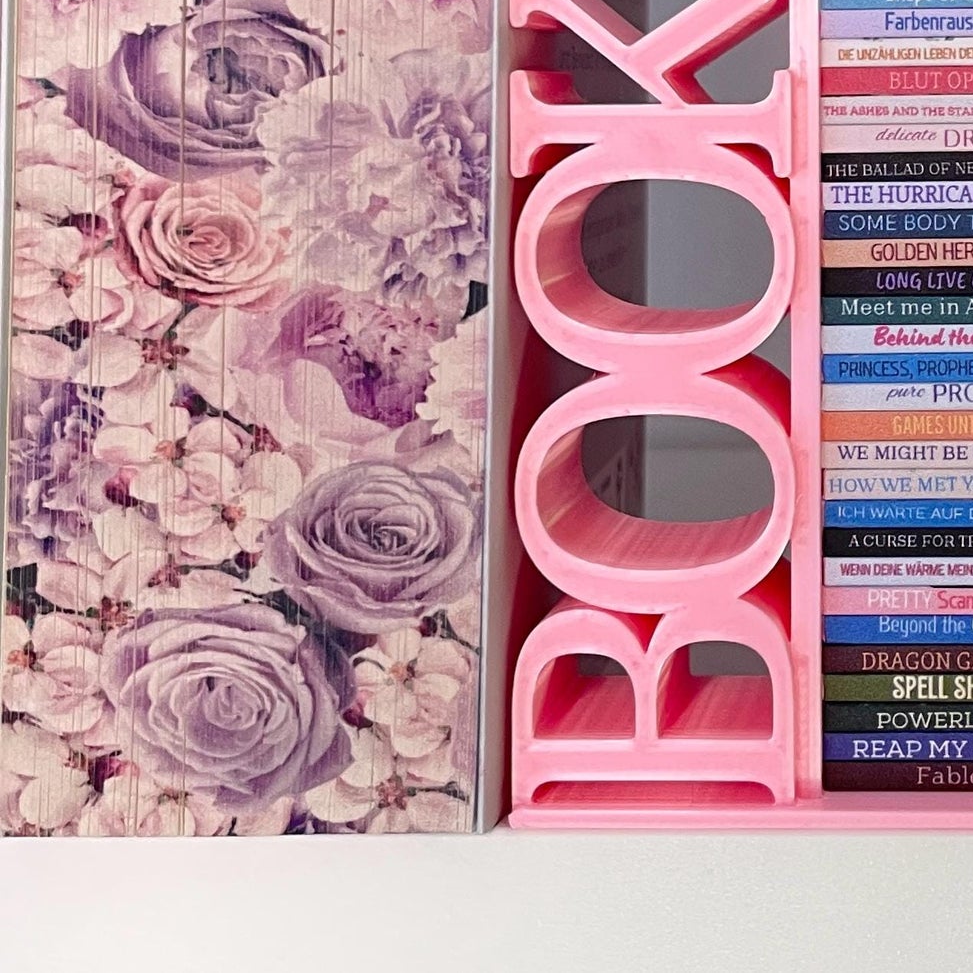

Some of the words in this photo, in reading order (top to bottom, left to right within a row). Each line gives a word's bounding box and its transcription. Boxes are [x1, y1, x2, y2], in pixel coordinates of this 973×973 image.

[890, 72, 944, 90] BLUT
[875, 128, 937, 141] delicate
[826, 164, 857, 177] THE
[862, 163, 924, 176] BALLAD
[929, 163, 950, 175] OF
[831, 186, 873, 204] THE
[839, 215, 897, 231] SOME
[904, 214, 961, 230] BODY
[871, 243, 937, 261] GOLDEN
[876, 272, 921, 291] LONG
[928, 272, 966, 289] LIVE
[841, 300, 894, 315] Meet
[901, 303, 932, 315] me
[940, 299, 959, 315] in
[874, 326, 945, 346] Behind
[839, 361, 913, 379] PRINCESS,
[838, 446, 868, 460] WE
[875, 446, 937, 460] MIGHT
[943, 446, 968, 460] BE
[849, 535, 859, 547] A
[862, 535, 917, 547] CURSE
[922, 535, 955, 547] FOR
[868, 589, 933, 608] PRETTY
[879, 616, 937, 637] Beyond
[942, 617, 966, 634] the
[862, 653, 950, 670] DRAGON
[893, 677, 949, 699] SPELL
[853, 740, 921, 758] REAP
[929, 740, 968, 758] MY
